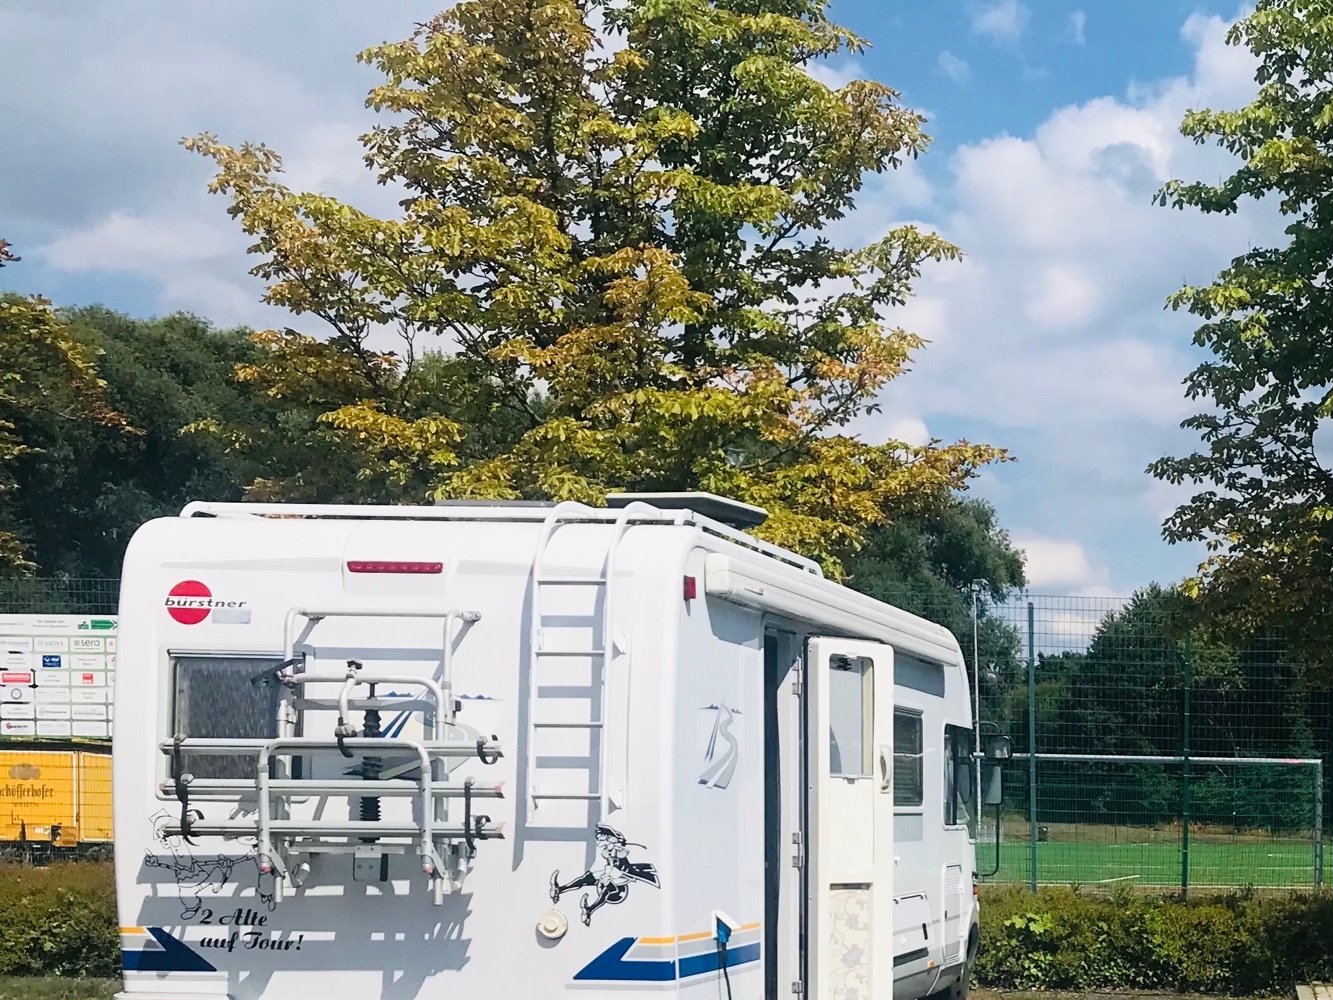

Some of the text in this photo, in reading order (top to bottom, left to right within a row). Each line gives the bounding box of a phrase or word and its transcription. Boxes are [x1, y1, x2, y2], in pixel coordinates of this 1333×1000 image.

[164, 597, 247, 608] bürstner
[80, 639, 100, 647] sera
[199, 907, 268, 927] 2 Alte
[200, 931, 304, 953] auf Tour!
